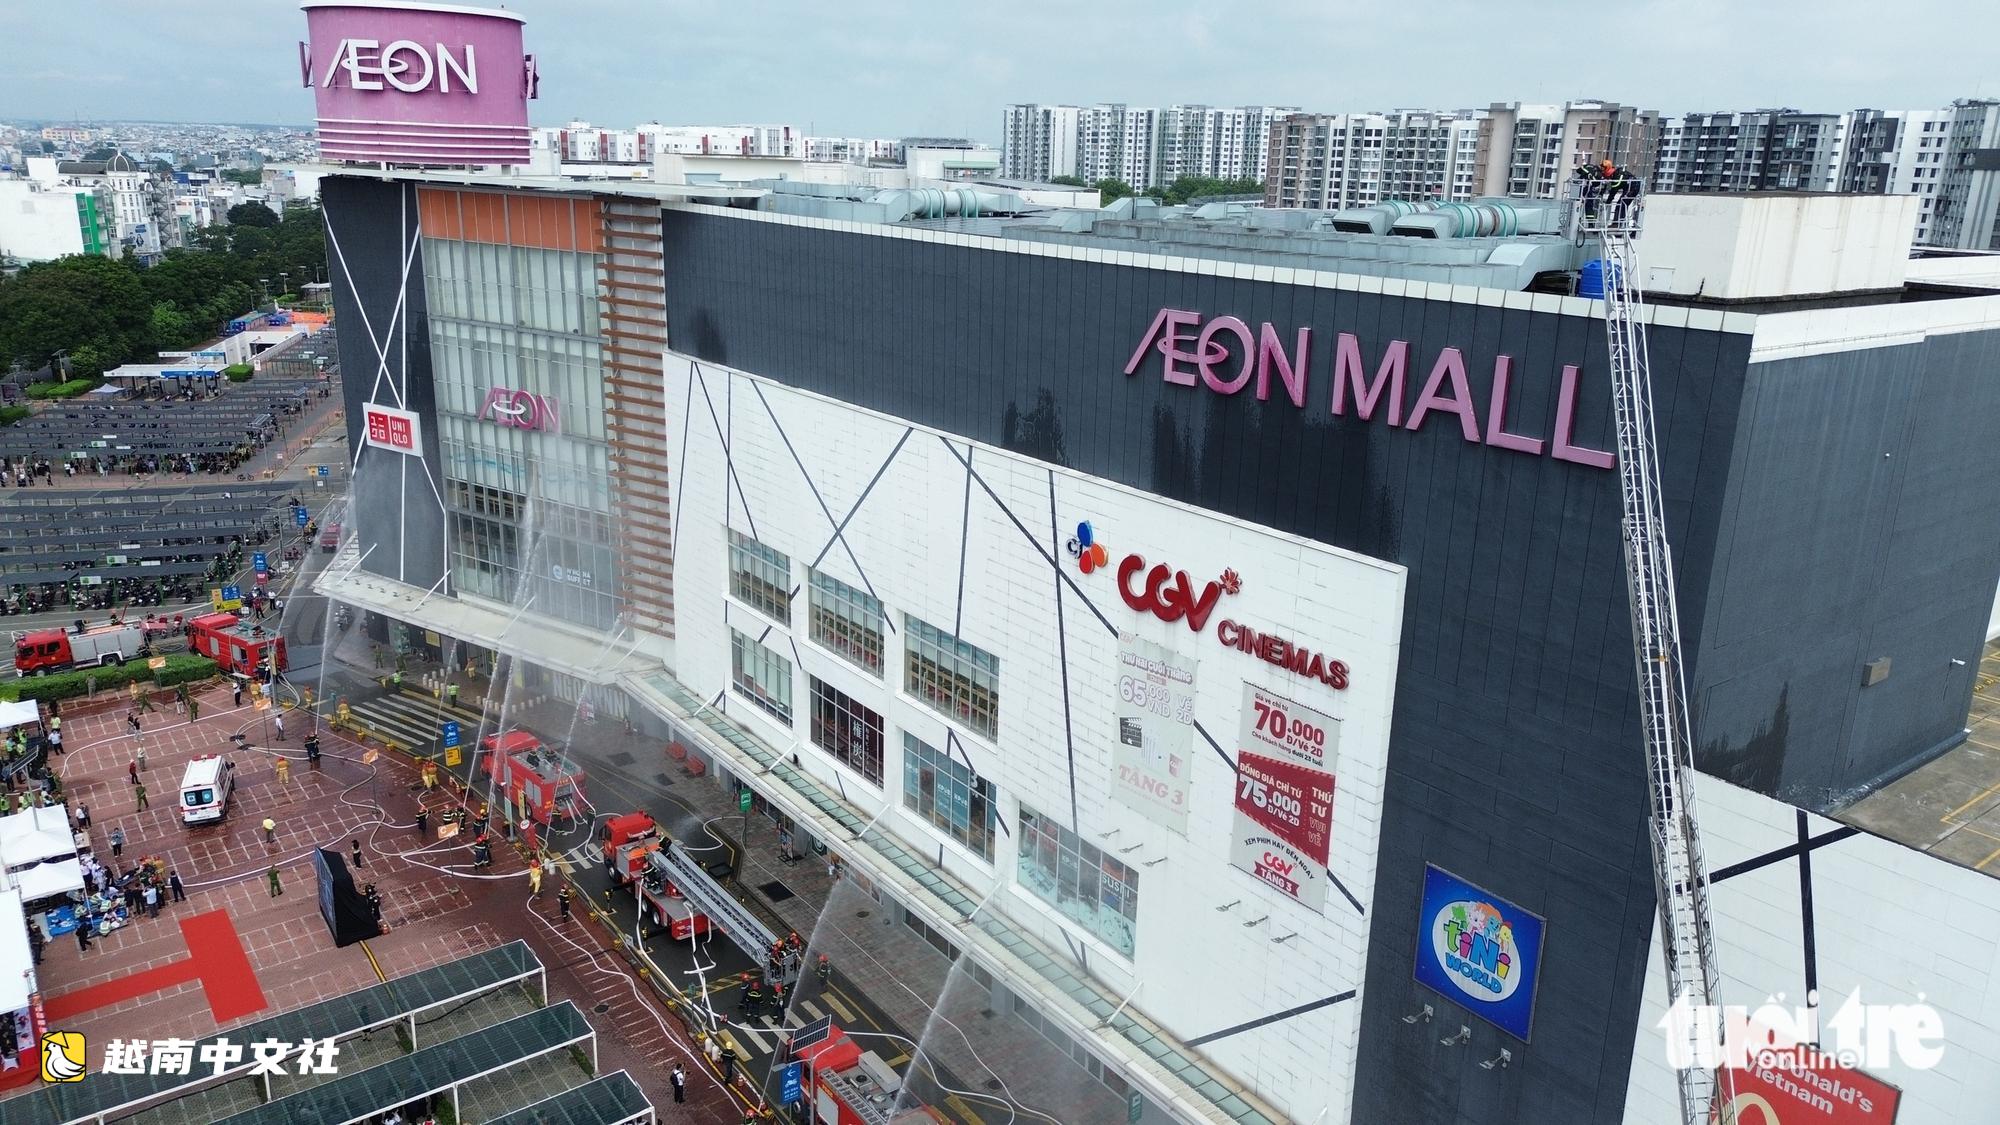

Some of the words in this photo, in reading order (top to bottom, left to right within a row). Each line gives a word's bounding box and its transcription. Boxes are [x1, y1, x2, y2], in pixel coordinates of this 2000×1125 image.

[1332, 333, 1615, 469] MALL
[391, 420, 406, 433] UNI
[392, 432, 408, 445] QLO
[1117, 553, 1222, 632] CGV
[1217, 619, 1350, 690] CINEMAS
[1147, 700, 1171, 718] VND
[1176, 709, 1193, 726] 2D
[1254, 701, 1325, 746] 70.000
[1310, 745, 1323, 758] 2D
[1261, 773, 1275, 787] GIÁ
[1276, 780, 1290, 793] CHỈ
[1171, 789, 1184, 806] 3
[1239, 774, 1301, 817] 75.000
[1312, 786, 1333, 804] THỨ
[1310, 801, 1327, 818] TƯ
[1288, 814, 1300, 827] 2D
[1263, 851, 1293, 877] CGV
[1286, 882, 1293, 892] 3
[1445, 952, 1503, 994] WORLD
